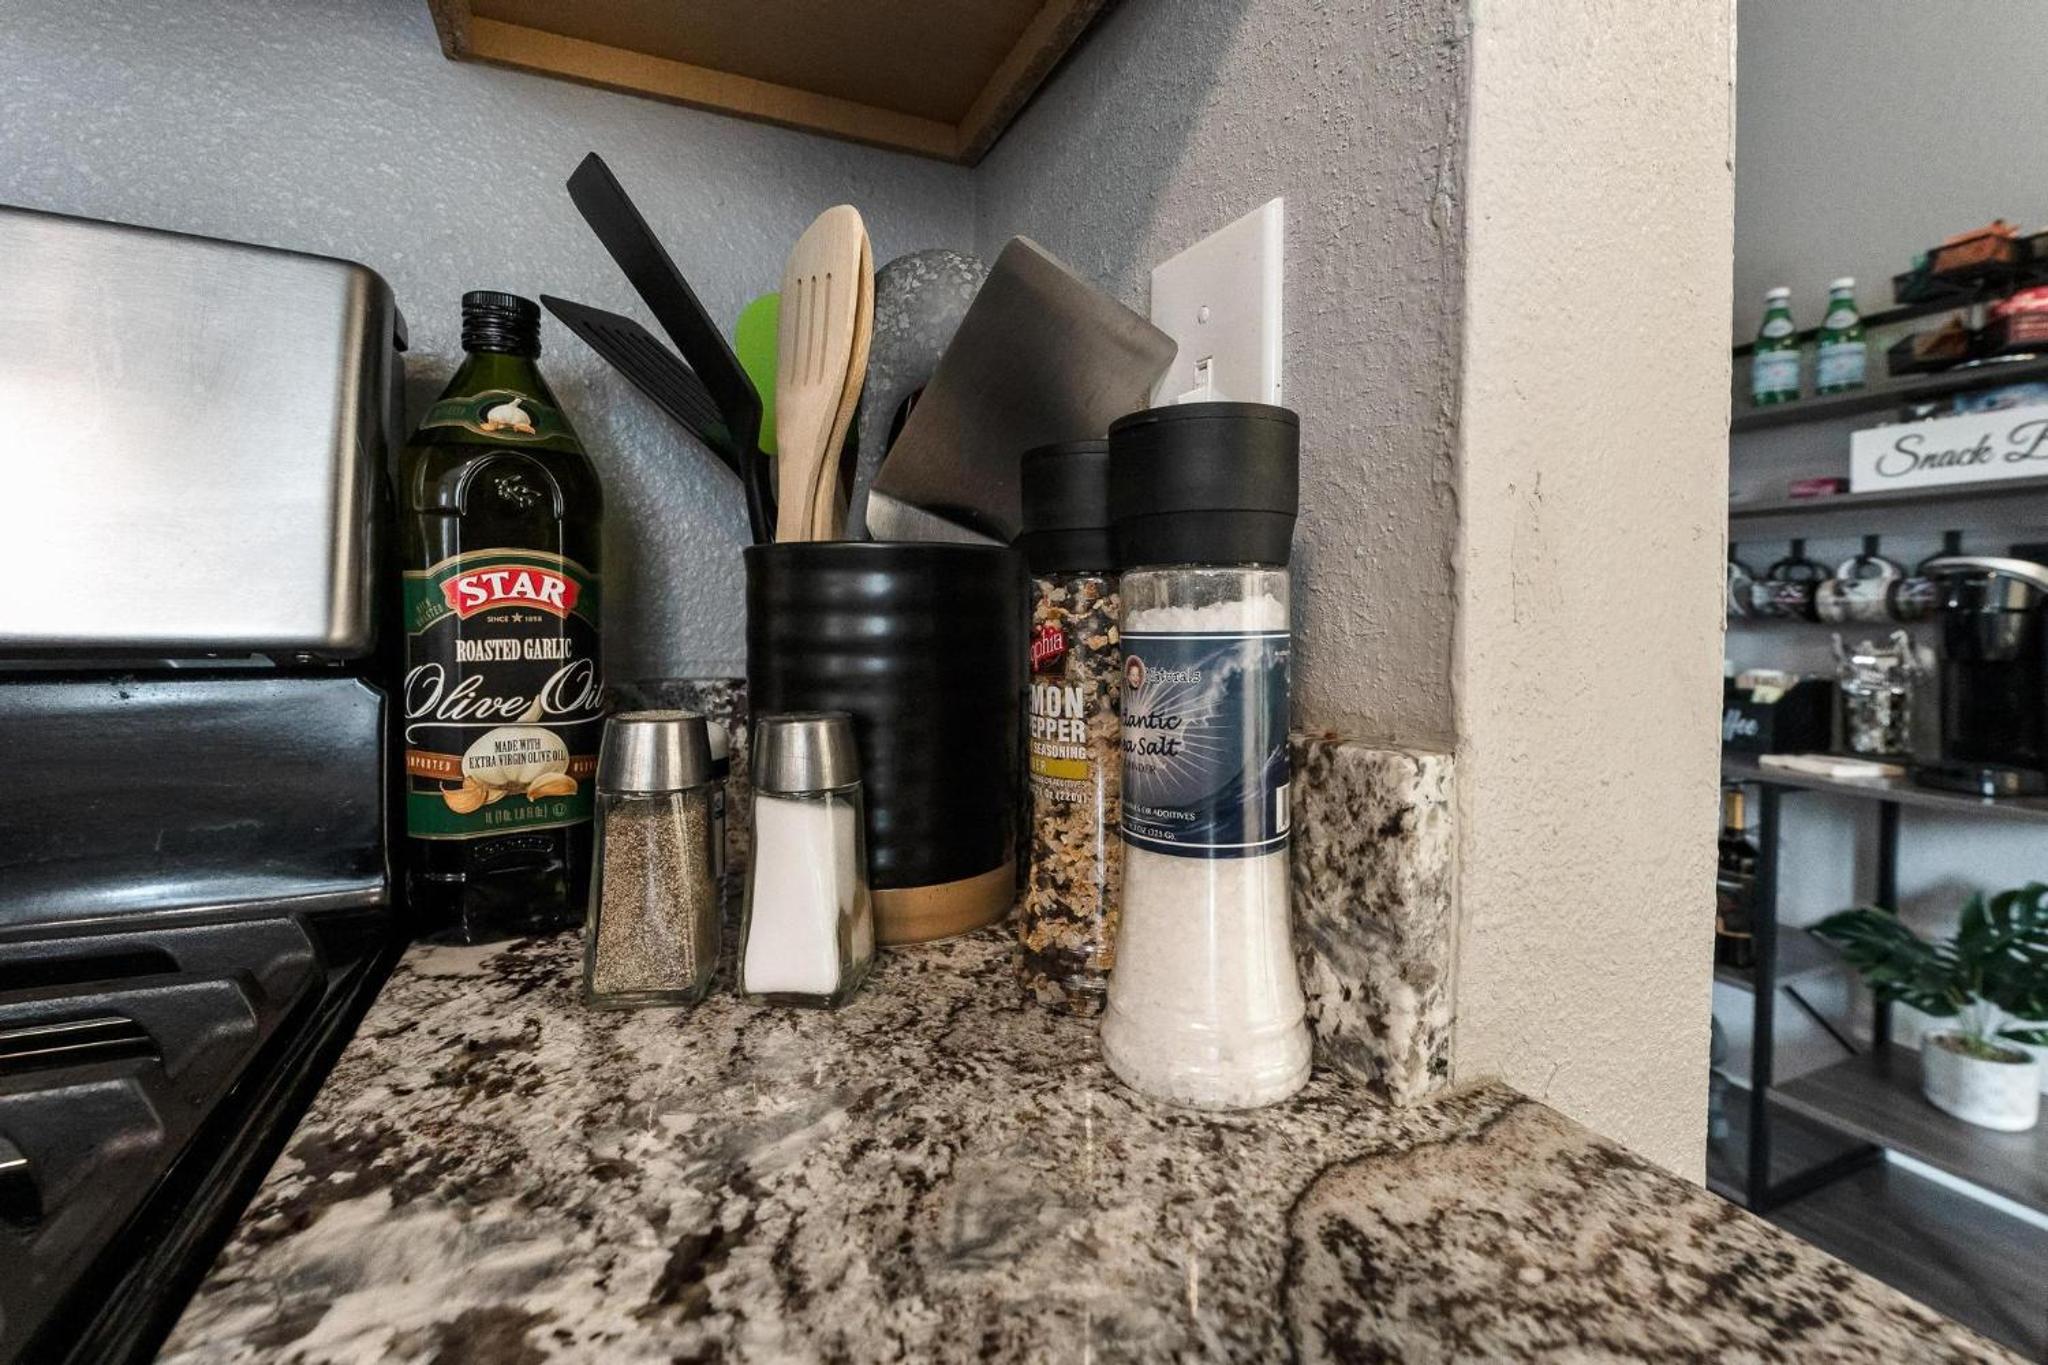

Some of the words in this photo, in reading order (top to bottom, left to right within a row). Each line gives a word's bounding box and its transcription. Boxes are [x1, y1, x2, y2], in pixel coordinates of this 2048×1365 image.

[1874, 433, 1993, 477] Snack
[457, 572, 566, 608] STAR
[487, 615, 508, 623] SINCE
[456, 639, 520, 662] ROASTED
[523, 638, 572, 659] GARLIC
[404, 663, 532, 720] Olive
[495, 740, 518, 753] MADE
[520, 738, 541, 750] WITH
[1137, 737, 1182, 757] Salt
[469, 755, 496, 769] EXTRA
[498, 752, 527, 766] VIRGIN
[528, 750, 551, 763] OLIVE
[553, 749, 565, 761] OIL
[1152, 808, 1196, 821] ADDITIVES
